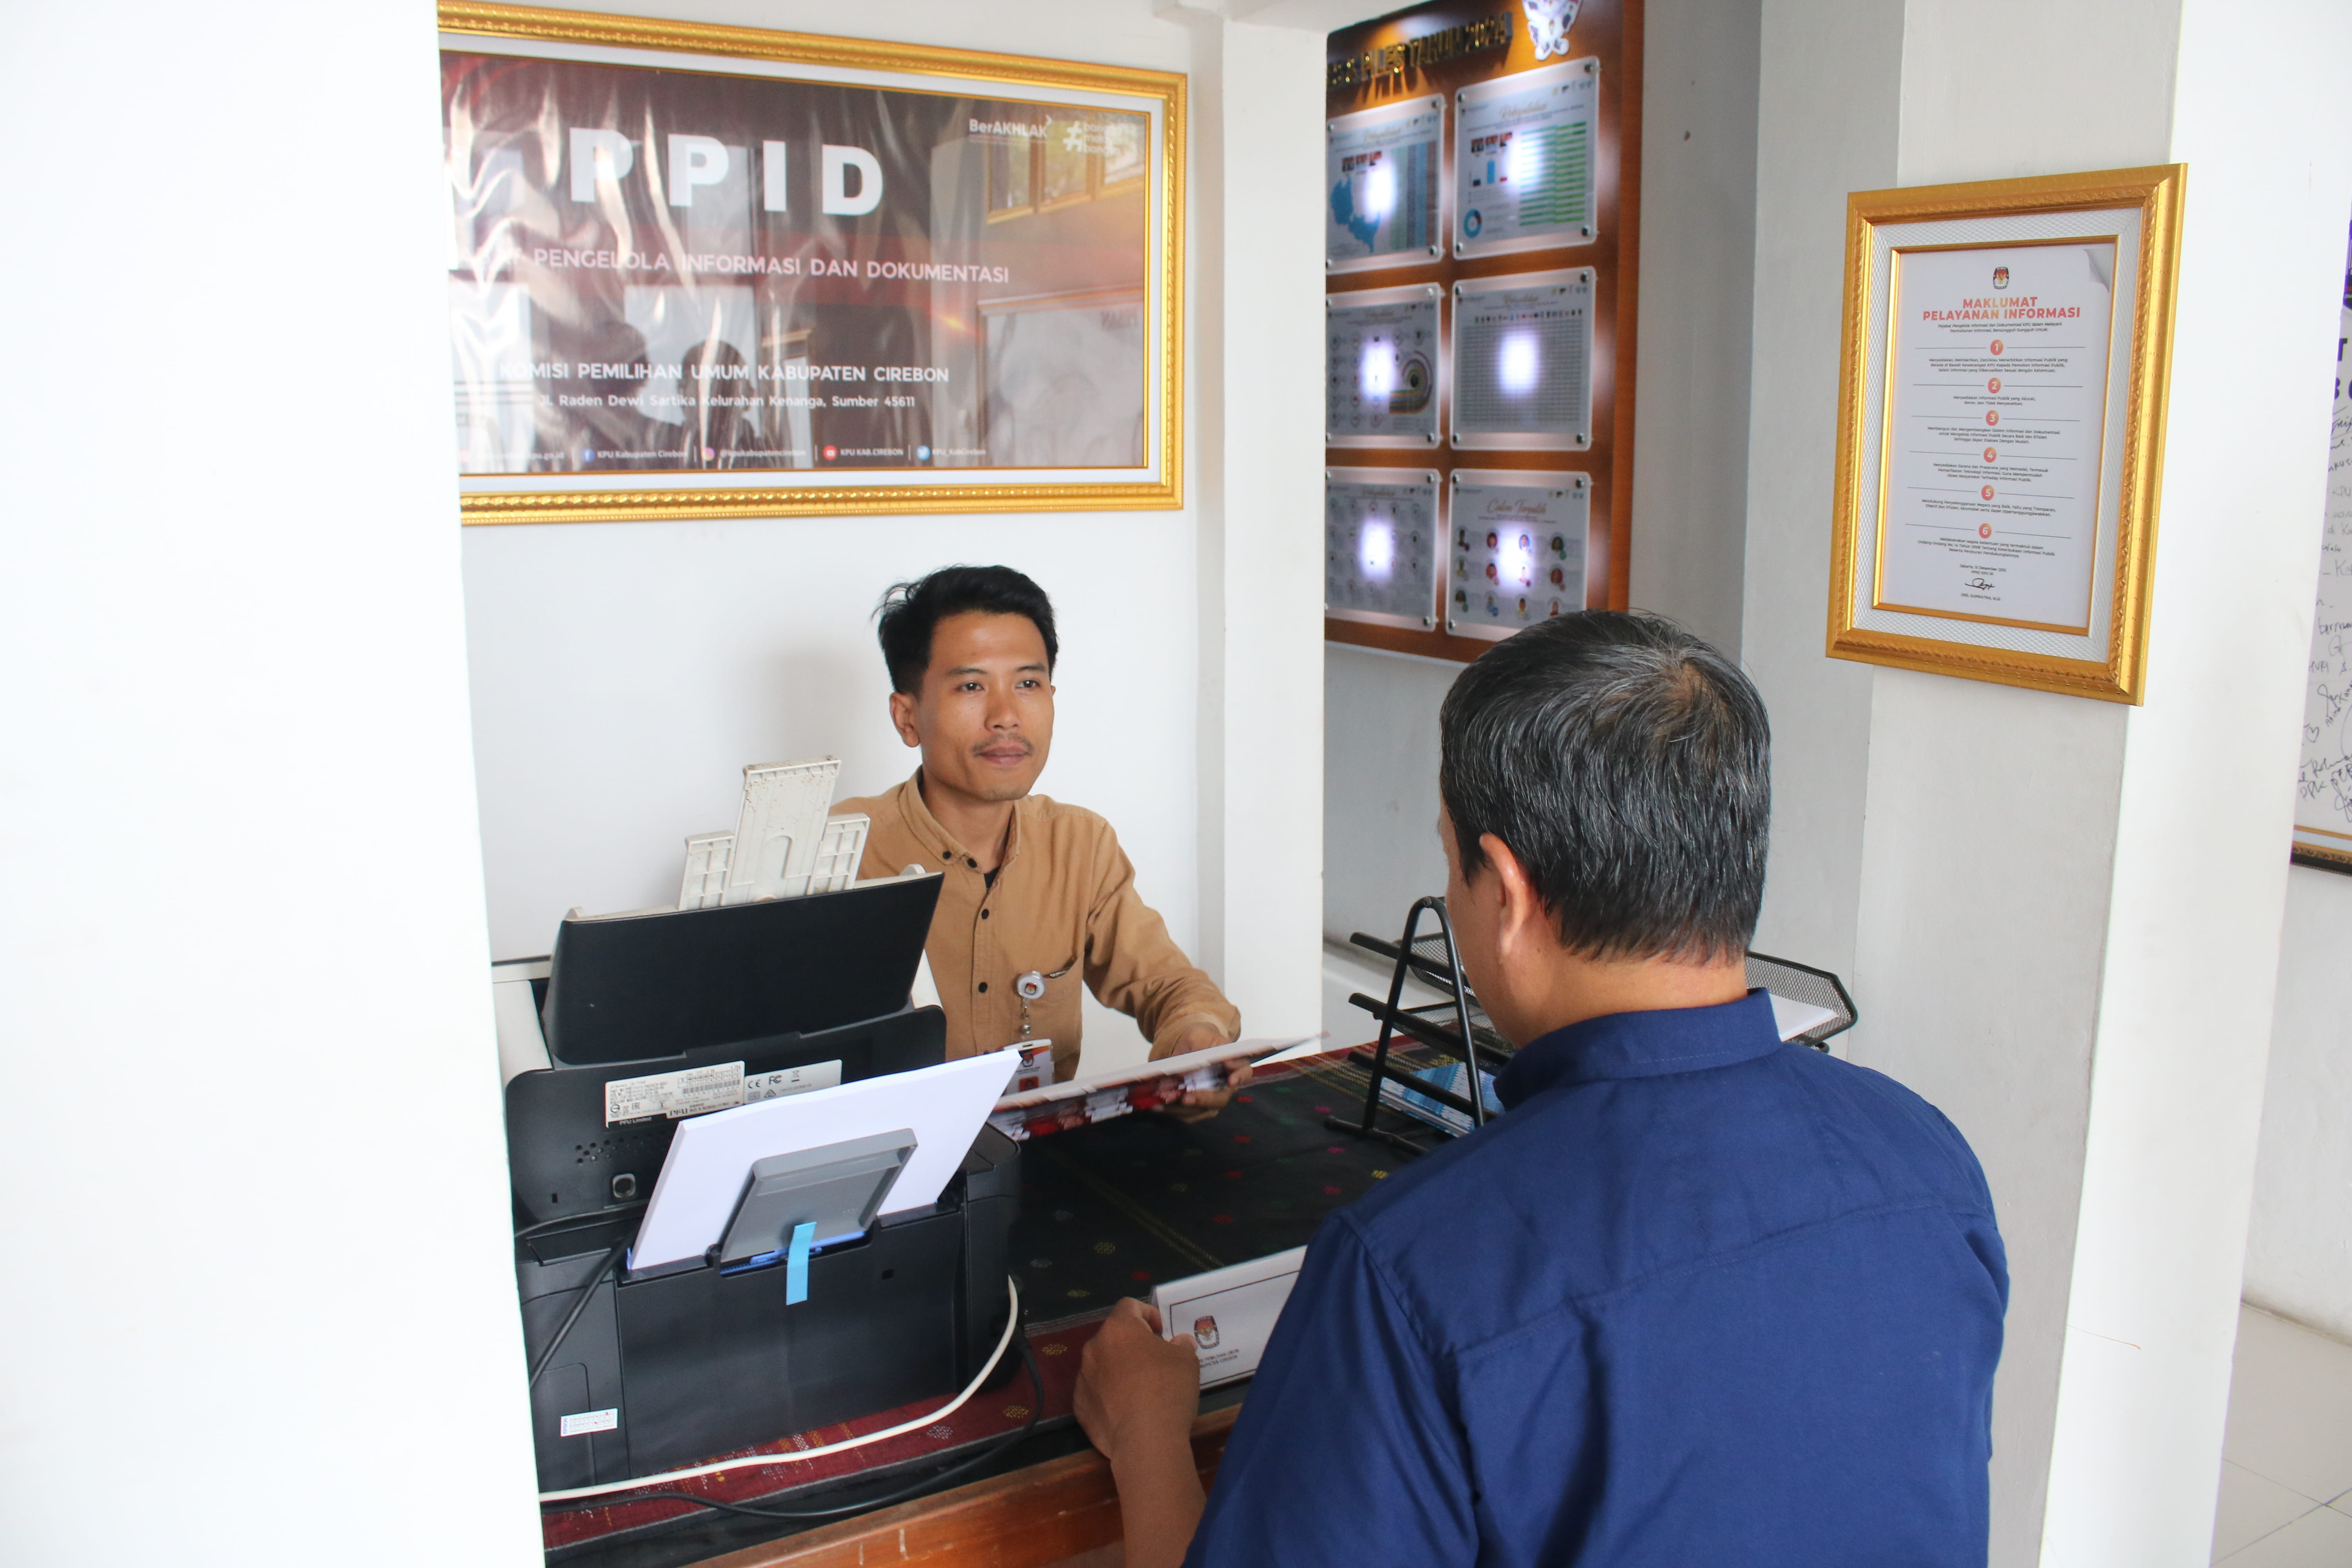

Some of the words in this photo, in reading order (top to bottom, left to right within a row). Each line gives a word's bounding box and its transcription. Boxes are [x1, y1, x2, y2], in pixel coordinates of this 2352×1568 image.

[969, 118, 1047, 137] BerAKHLAK
[534, 248, 670, 271] PENGELOLA
[682, 253, 800, 275] INFORMASI
[811, 259, 858, 277] DAN
[867, 261, 1009, 283] DOKUMENTASI
[1963, 297, 2038, 309] MAKLUMAT
[1923, 310, 1999, 321] PELAYANAN
[2004, 307, 2080, 319] INFORMASI
[1995, 343, 1998, 352] 1
[500, 363, 569, 379] KOMISI
[578, 363, 683, 380] PEMILIHAN
[691, 364, 750, 381] UMUM
[758, 365, 866, 382] KABUPATEN
[874, 366, 949, 383] CIREBON
[1992, 381, 1997, 390] 2
[559, 395, 603, 407] Raden
[608, 395, 645, 407] Dewi
[650, 395, 696, 407] Sartika
[702, 395, 764, 407] Kelurahan
[769, 396, 827, 409] Kenanga,
[832, 396, 879, 408] Sumber
[884, 396, 915, 408] 45611
[1990, 414, 1995, 422] 3
[597, 450, 613, 459] KPU
[615, 450, 656, 462] Kabupaten
[840, 448, 855, 457] KPU
[857, 448, 904, 457] KAB.CIREBON
[1982, 527, 1988, 535] 6
